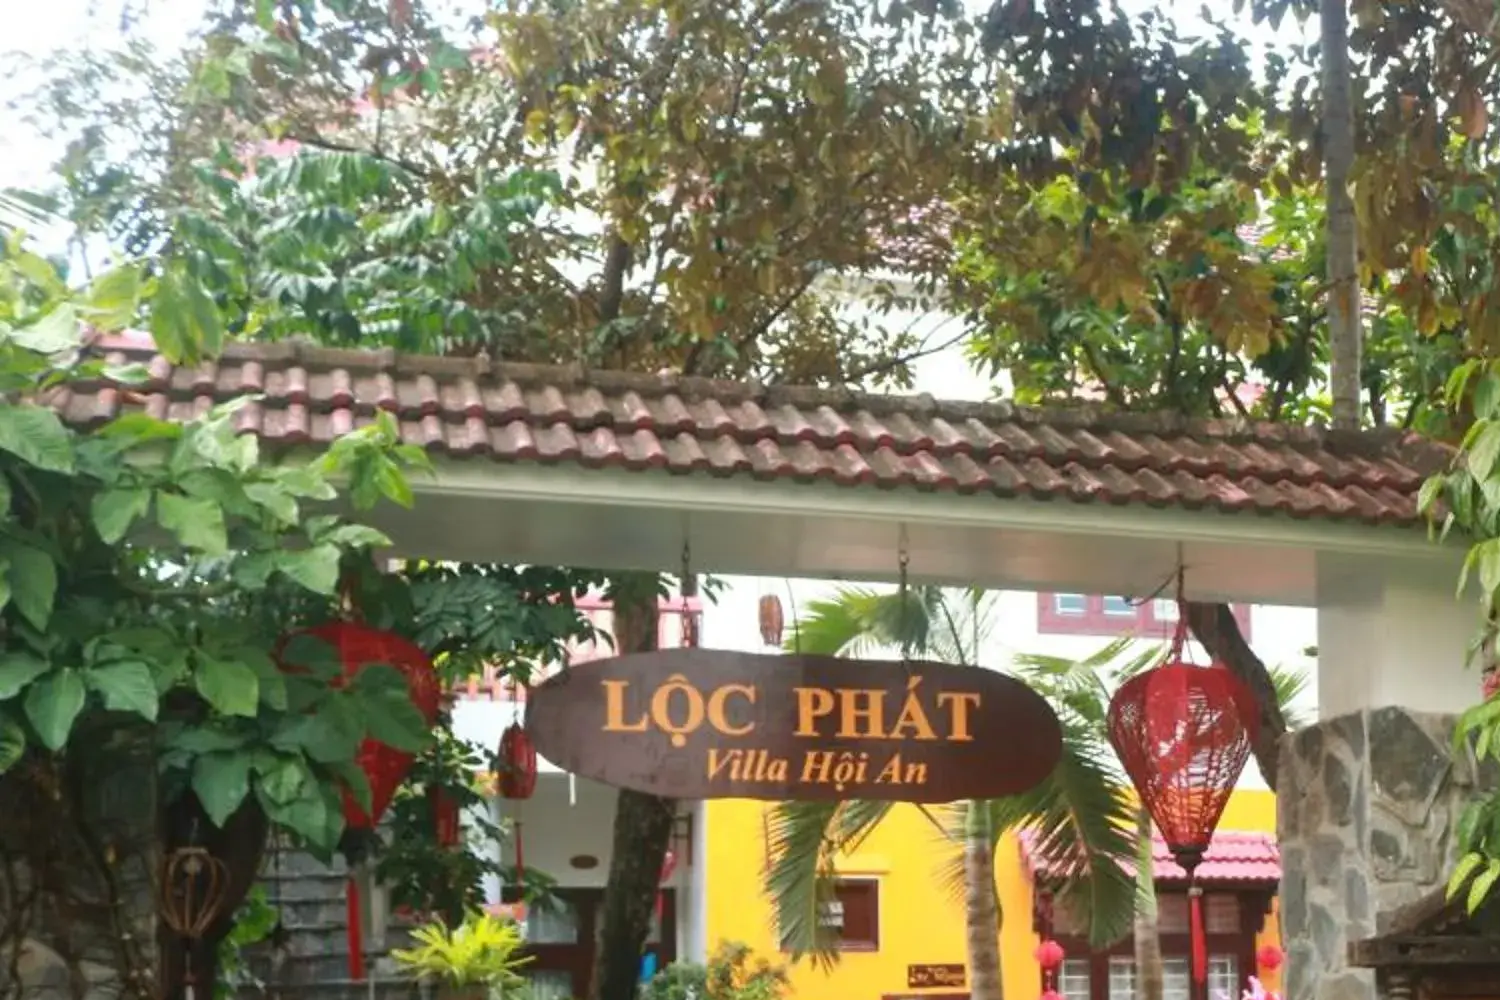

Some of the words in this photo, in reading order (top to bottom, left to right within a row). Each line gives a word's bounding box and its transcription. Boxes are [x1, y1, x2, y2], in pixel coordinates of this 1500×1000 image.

[601, 674, 756, 748] LỘC
[792, 675, 981, 742] PHÁT
[706, 749, 788, 783] Villa
[800, 751, 869, 792] Hội
[873, 753, 928, 784] An
